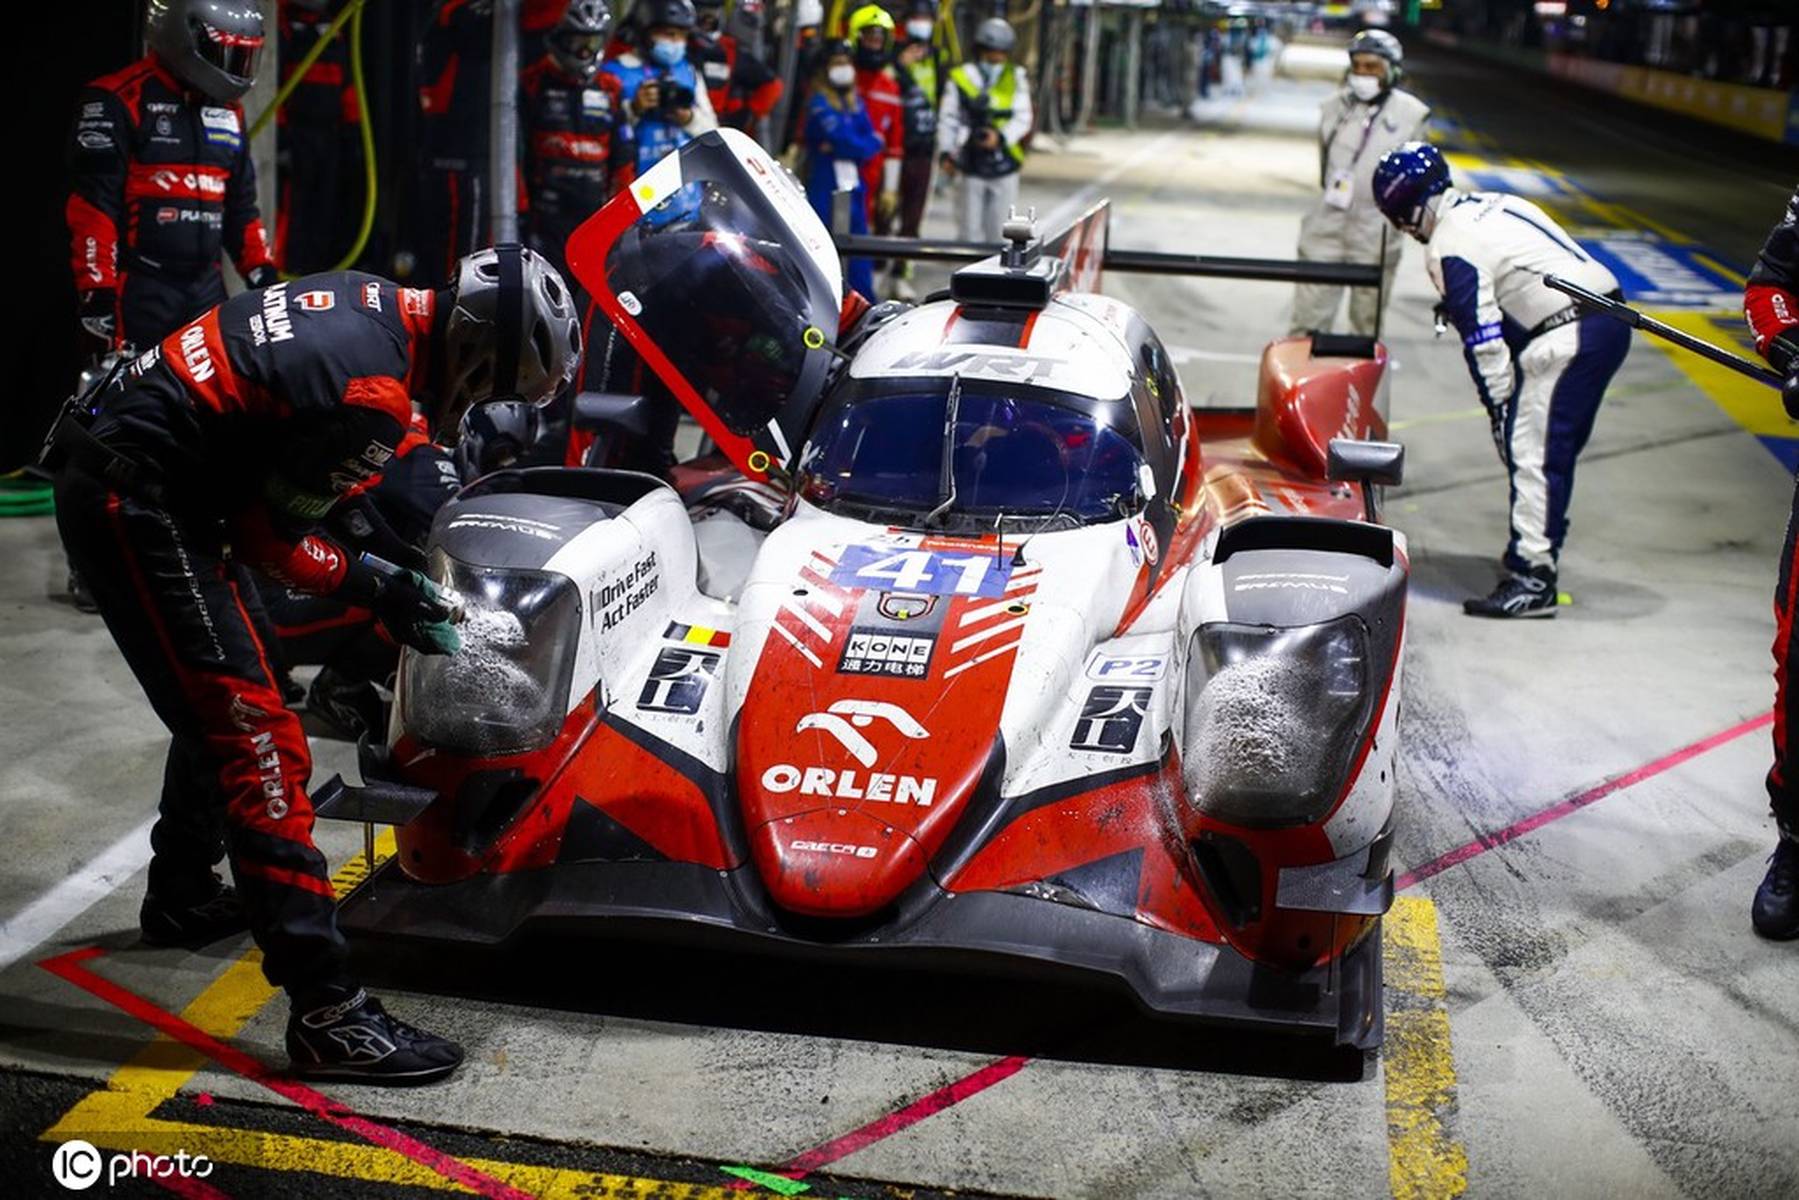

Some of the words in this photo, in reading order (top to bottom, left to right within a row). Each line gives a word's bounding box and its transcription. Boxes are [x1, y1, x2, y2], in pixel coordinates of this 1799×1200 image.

[180, 325, 216, 384] ORLEN
[889, 351, 1068, 377] WRT
[601, 572, 634, 608] Drive
[634, 551, 657, 582] Fast
[856, 551, 992, 593] 41
[601, 604, 625, 634] Act
[626, 574, 659, 615] Faster
[851, 641, 927, 656] KONE
[1098, 660, 1162, 675] P2
[250, 731, 289, 819] ORLEN
[762, 764, 937, 806] ORLEN
